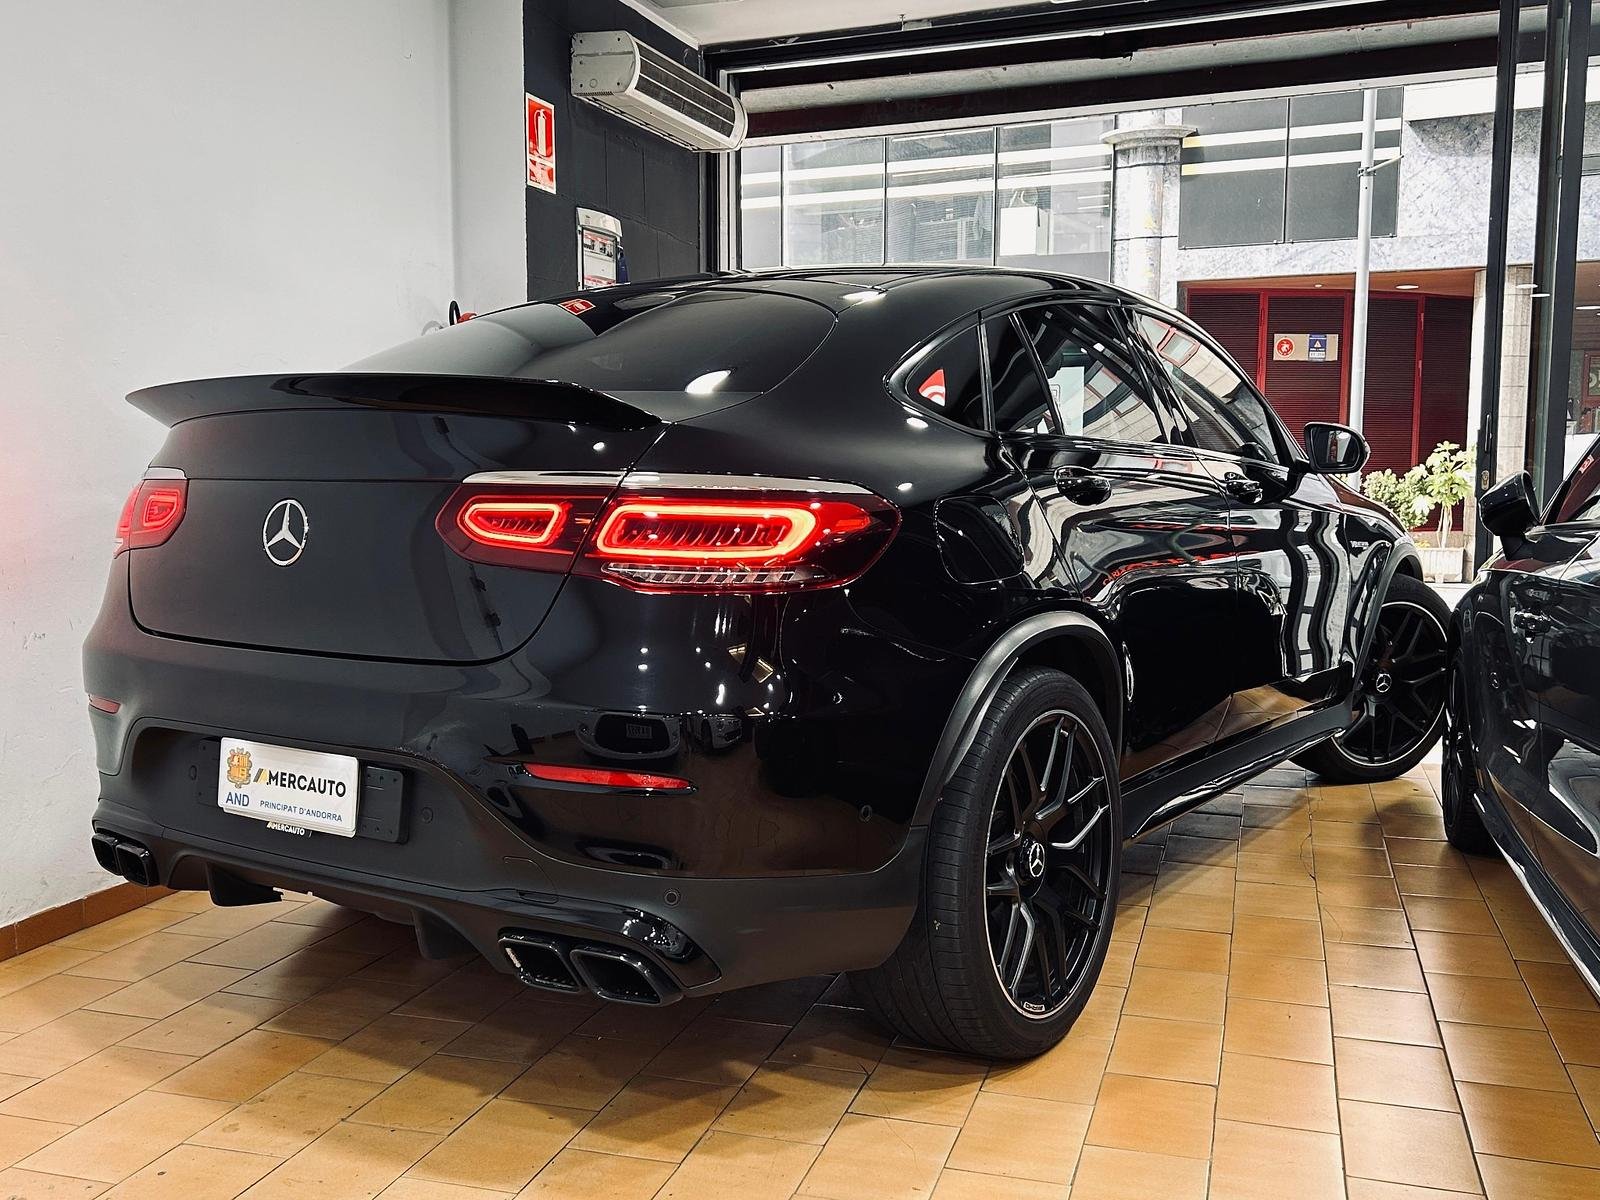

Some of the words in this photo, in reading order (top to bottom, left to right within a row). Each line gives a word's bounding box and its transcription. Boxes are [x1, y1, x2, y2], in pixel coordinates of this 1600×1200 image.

[267, 769, 347, 798] MERCAUTO
[226, 791, 250, 807] AND
[259, 799, 297, 815] PRINCIPAT
[299, 807, 343, 822] D'ANDORRA
[271, 822, 306, 836] MERCAUTO
